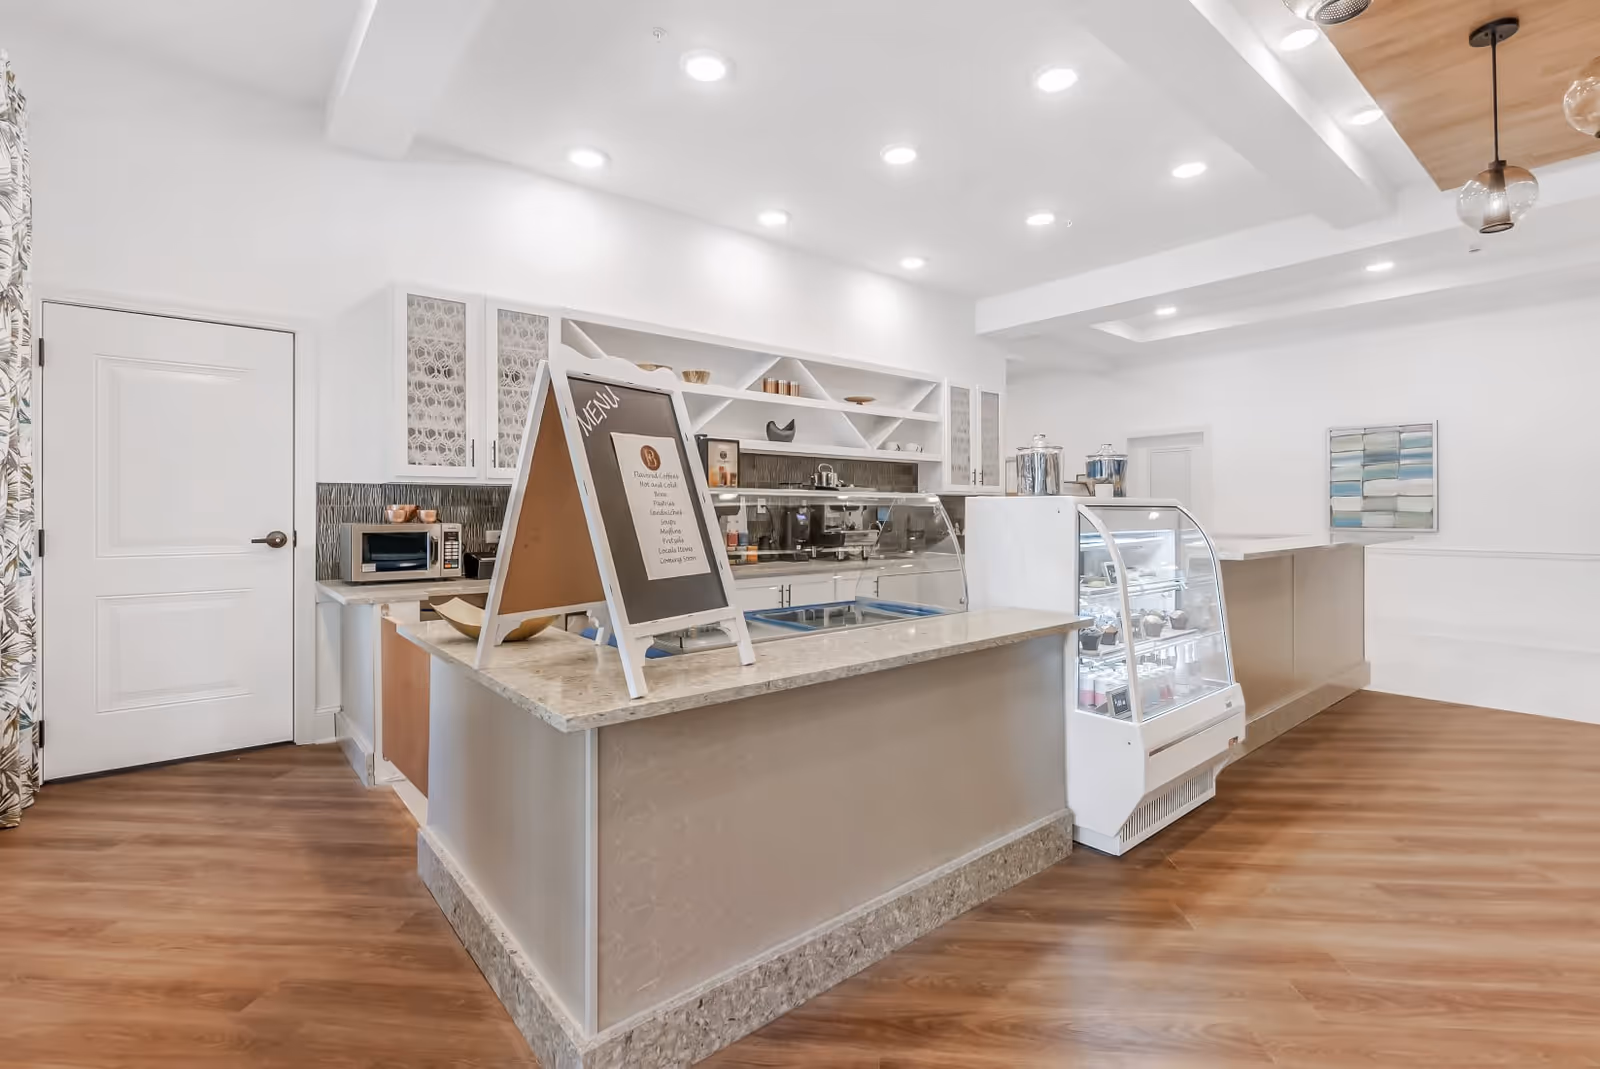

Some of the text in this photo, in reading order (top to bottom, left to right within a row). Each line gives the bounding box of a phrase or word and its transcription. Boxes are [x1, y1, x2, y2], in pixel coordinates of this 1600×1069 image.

[576, 385, 620, 437] MENU
[639, 480, 650, 488] Hot
[660, 518, 676, 526] Soups
[660, 557, 682, 565] Coming
